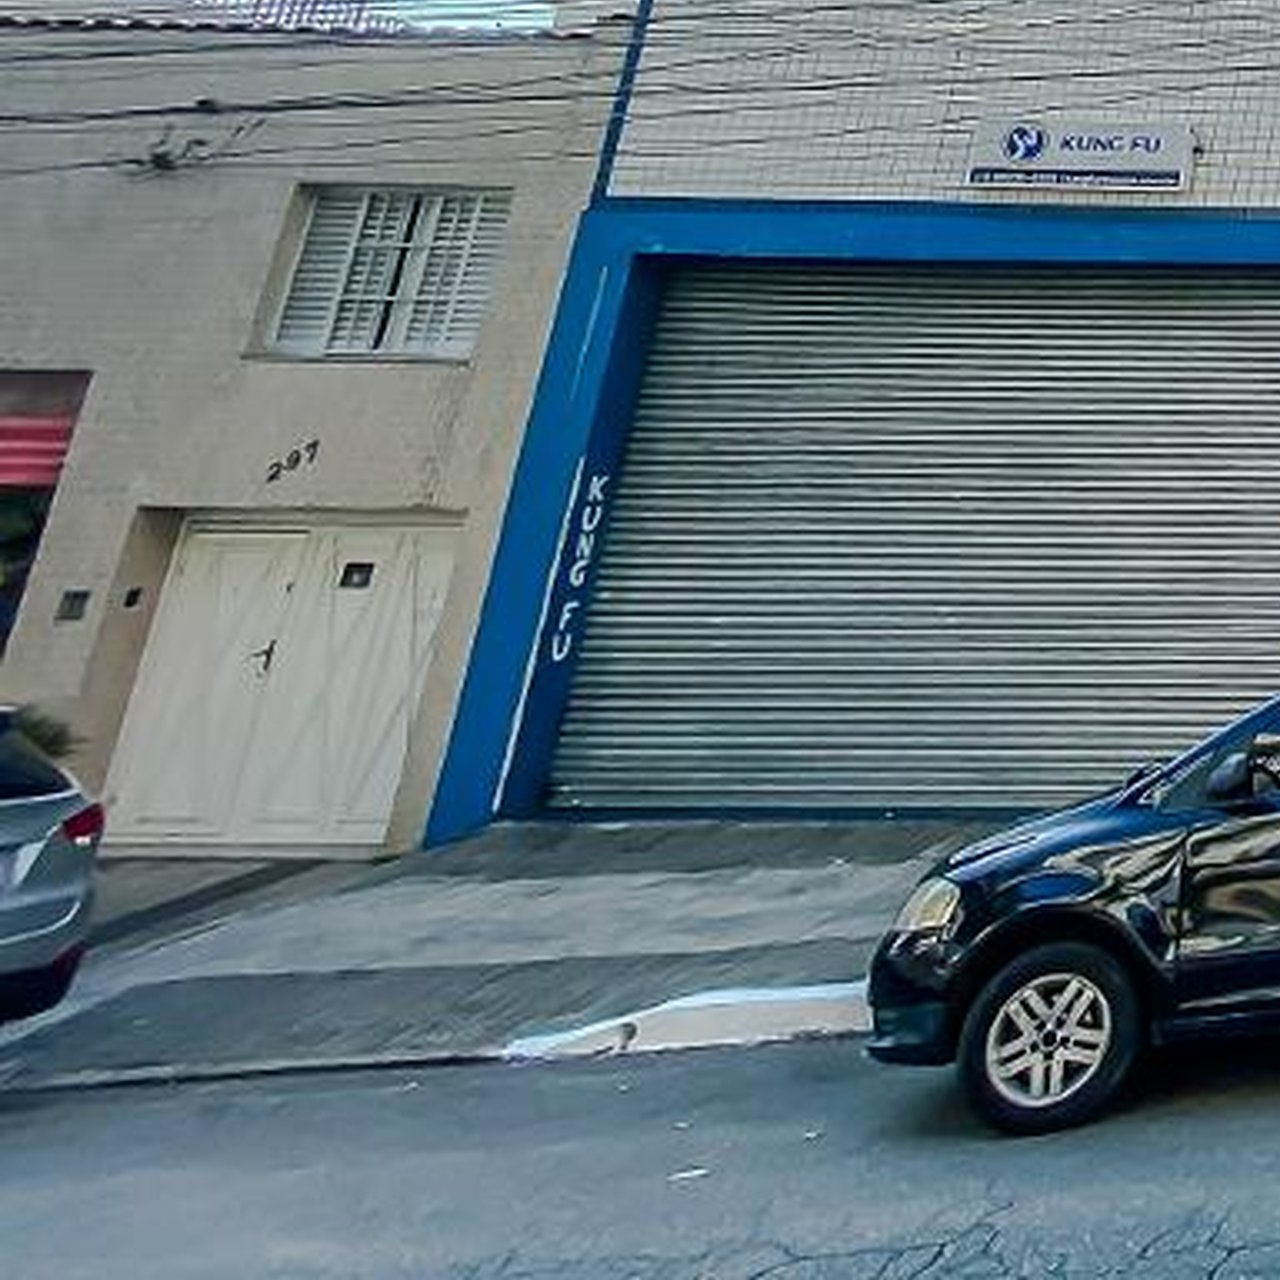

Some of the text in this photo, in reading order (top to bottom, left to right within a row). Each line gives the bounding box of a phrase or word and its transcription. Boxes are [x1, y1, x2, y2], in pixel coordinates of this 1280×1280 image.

[1058, 135, 1163, 155] KUNG FU
[552, 475, 609, 662] KUNG FU
